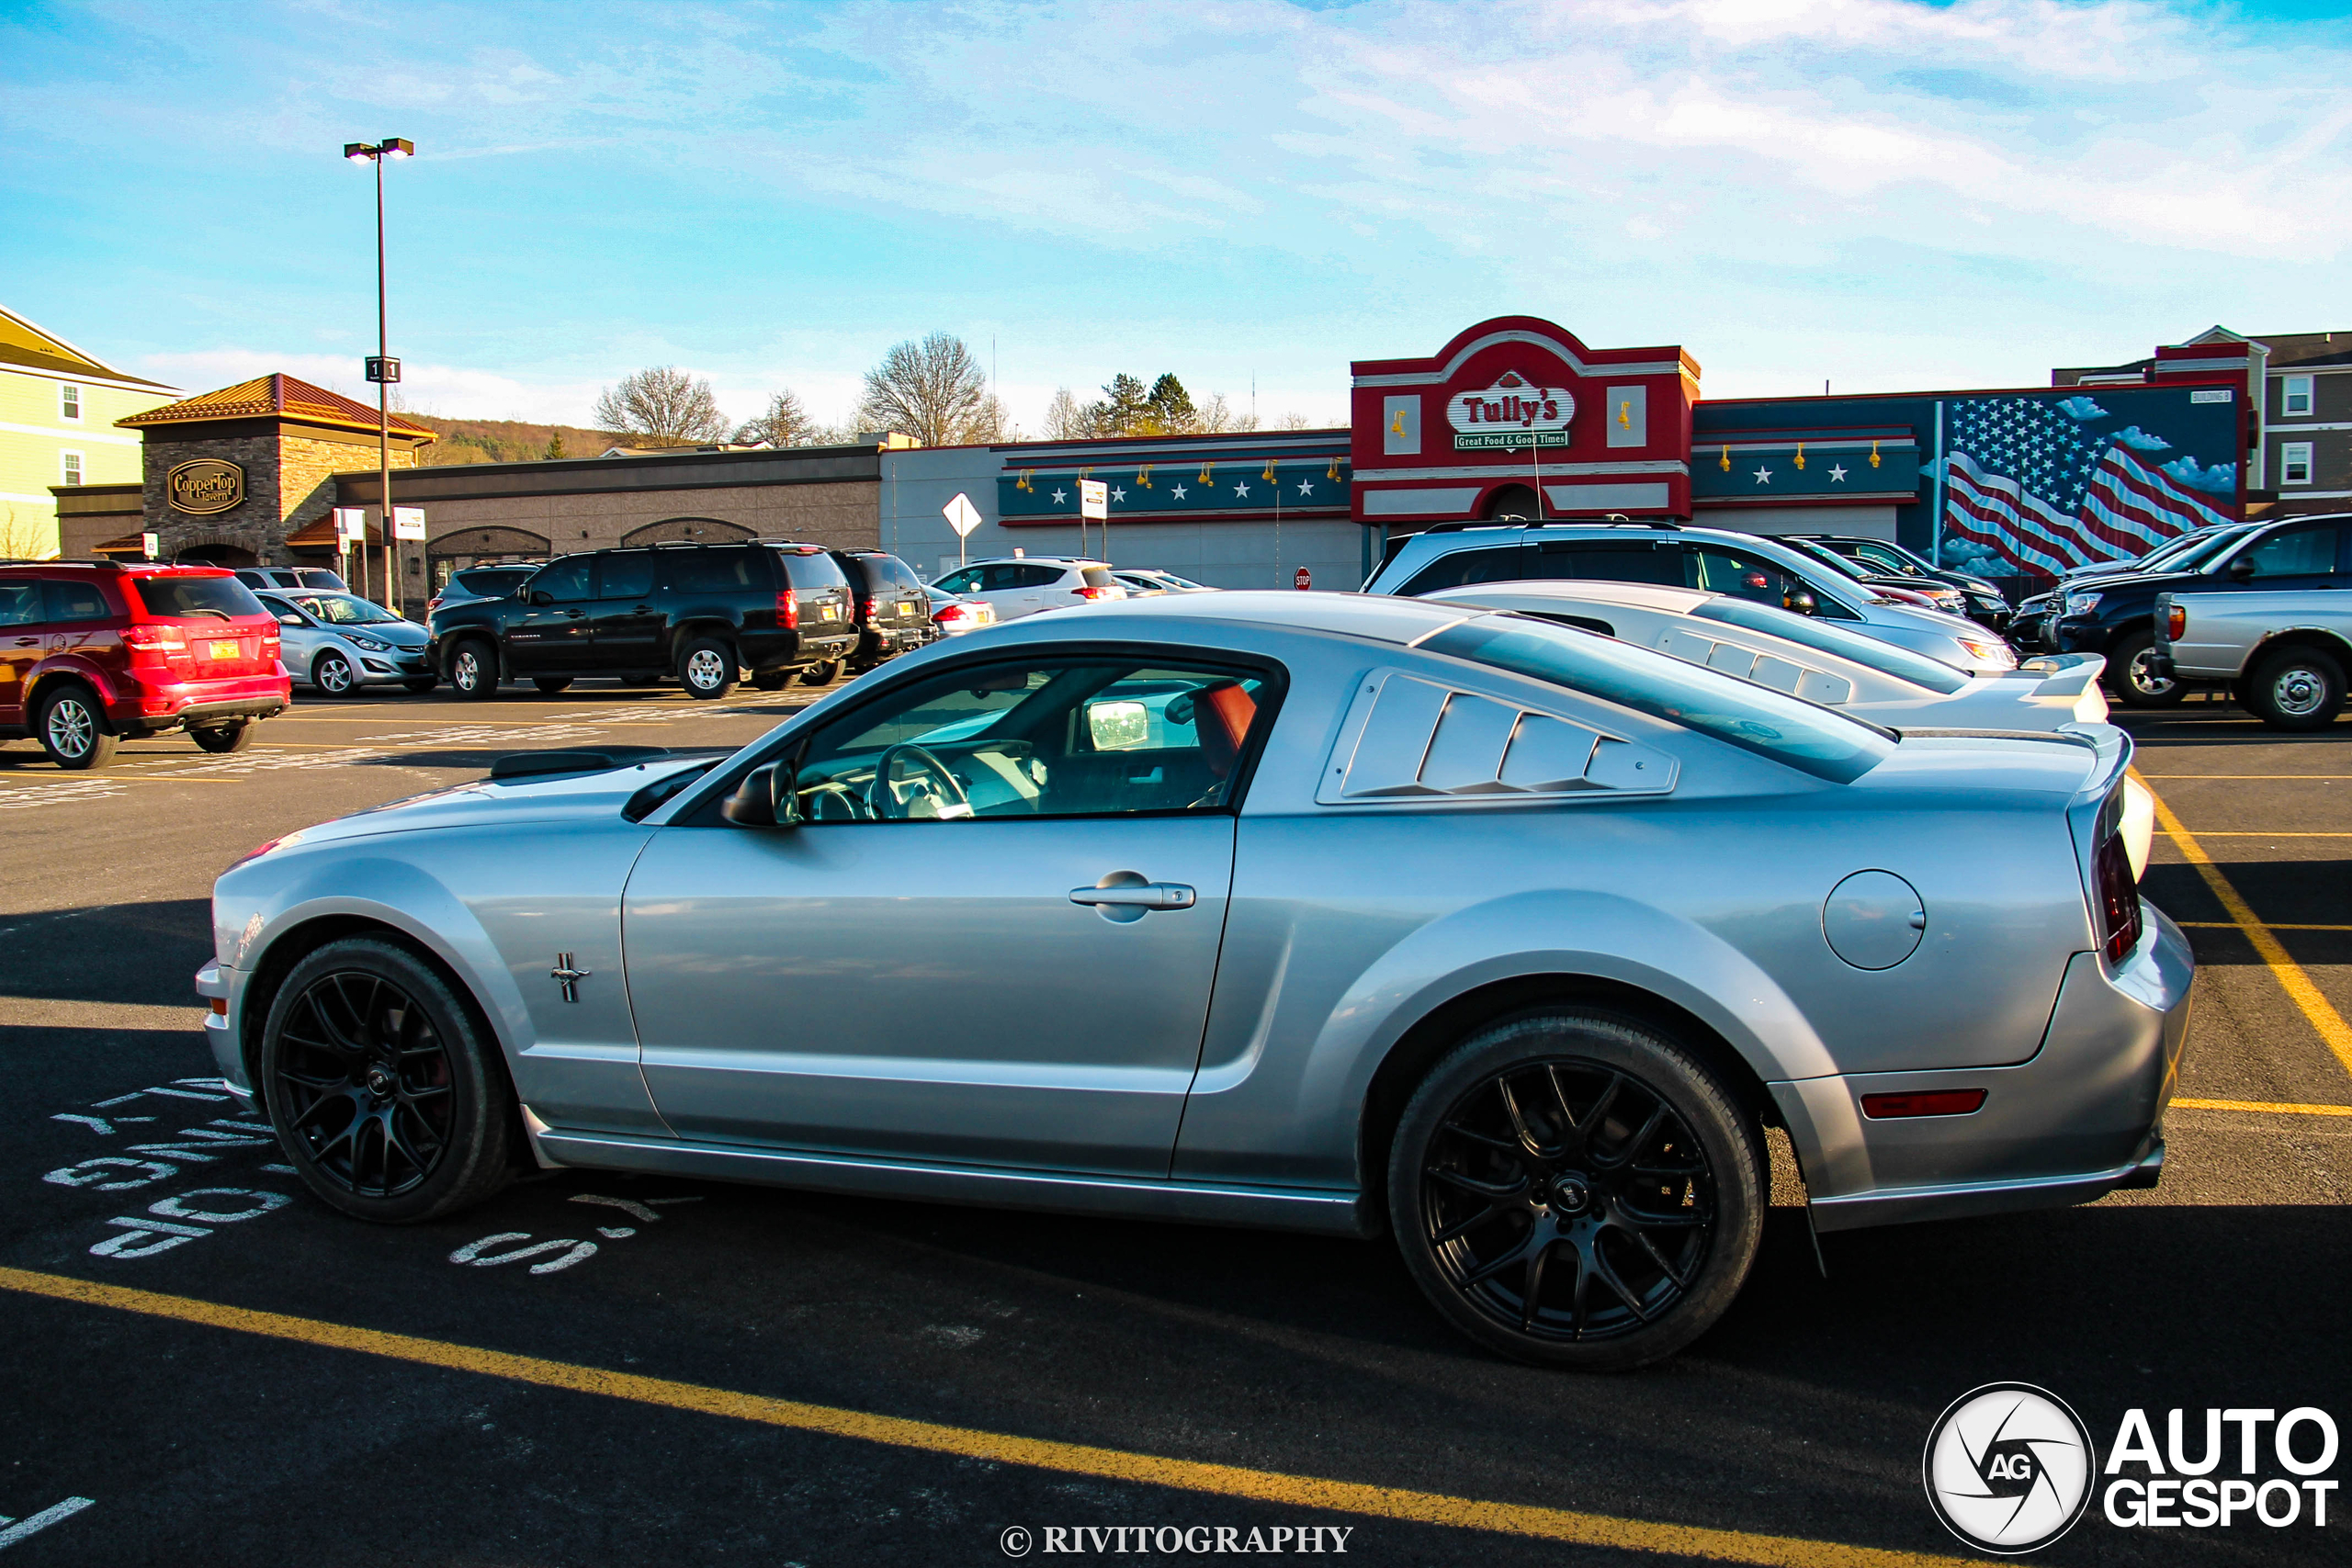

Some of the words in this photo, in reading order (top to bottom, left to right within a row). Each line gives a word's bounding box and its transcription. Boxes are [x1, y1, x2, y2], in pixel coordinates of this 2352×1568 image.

[372, 362, 378, 375] 1
[389, 363, 396, 377] 1
[1463, 388, 1558, 427] Tully's
[1458, 436, 1482, 446] Great
[1484, 435, 1505, 446] Food
[1507, 435, 1513, 445] &
[1515, 434, 1537, 444] Good
[1539, 434, 1566, 444] Times
[174, 472, 236, 498] CopperTop
[200, 491, 228, 502] Tavern
[1296, 576, 1310, 585] STOP
